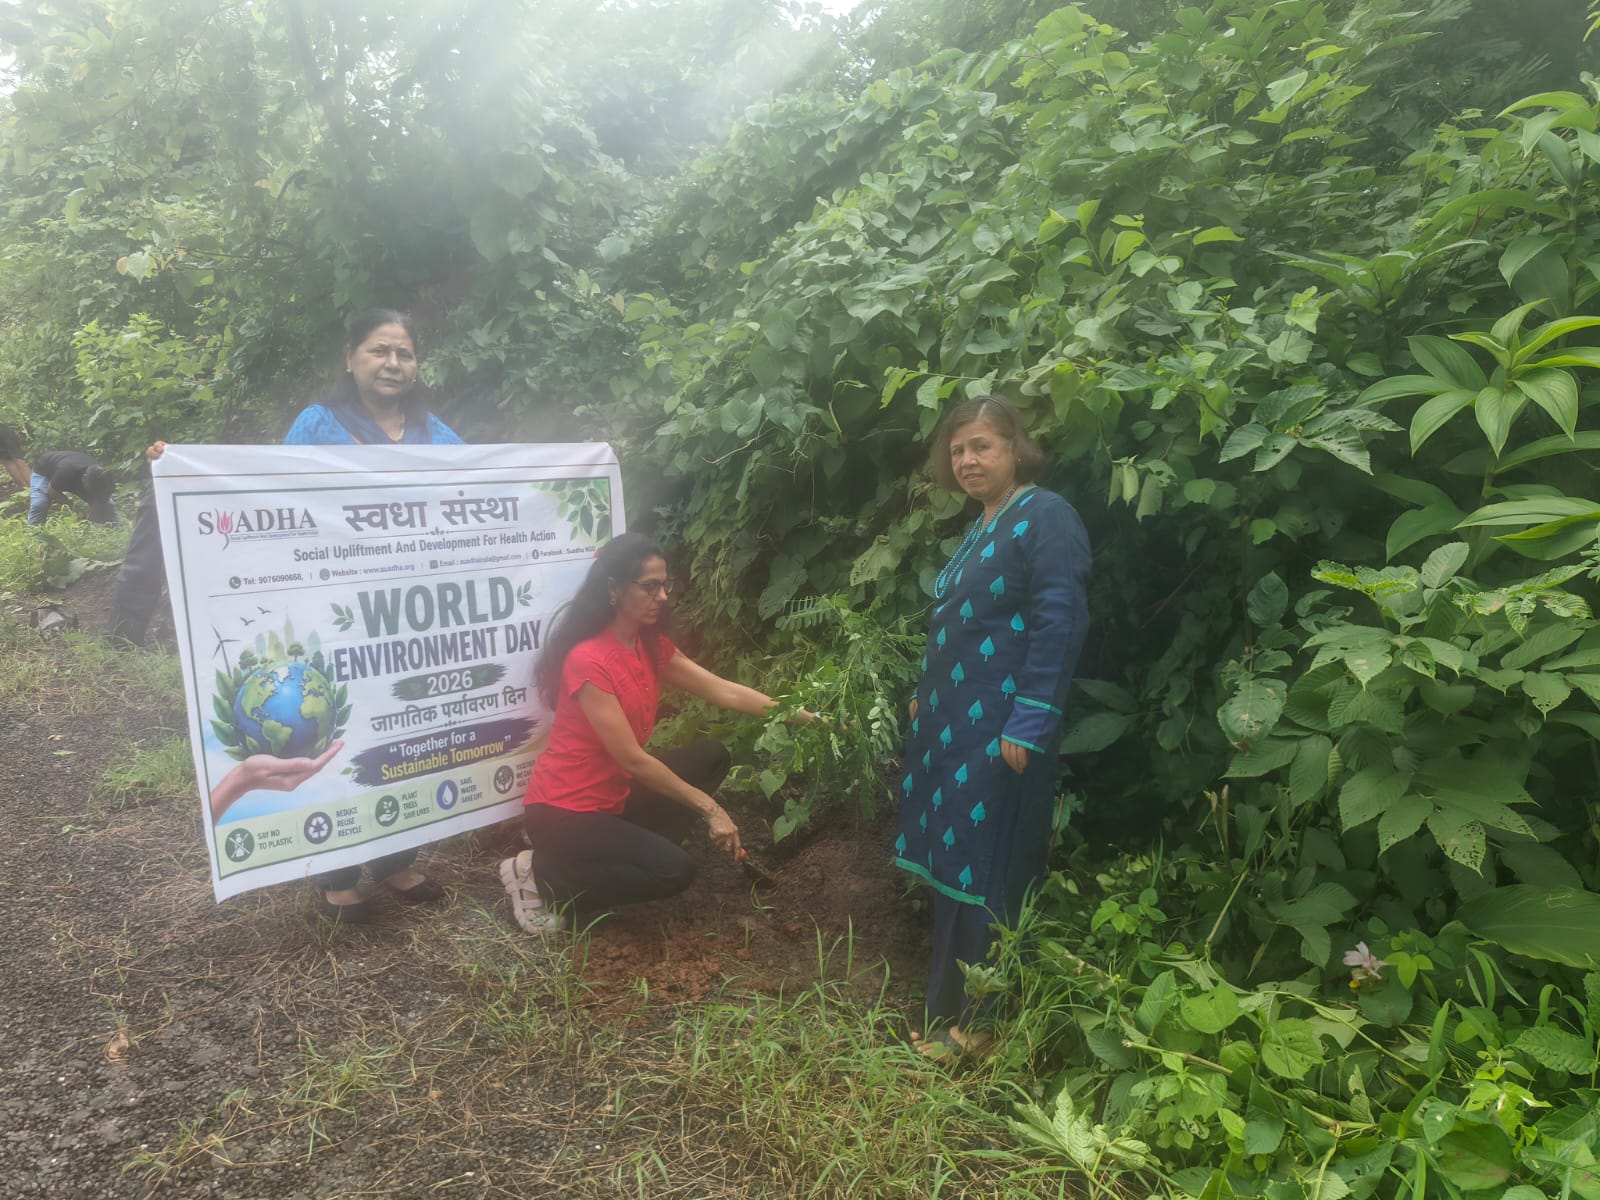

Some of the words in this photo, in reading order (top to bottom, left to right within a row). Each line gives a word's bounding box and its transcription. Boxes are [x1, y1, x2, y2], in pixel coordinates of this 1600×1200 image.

[342, 501, 428, 532] स्वधा
[439, 490, 520, 526] संस्था
[293, 546, 329, 561] Social
[333, 543, 392, 560] Upliftment
[395, 541, 417, 553] And
[419, 537, 481, 552] Development
[483, 535, 498, 546] For
[500, 532, 528, 544] Health
[530, 529, 557, 541] Action
[331, 568, 358, 577] Website
[357, 576, 515, 639] WORLD
[334, 626, 498, 682] ENVIRONMENT
[504, 619, 542, 655] DAY
[427, 671, 473, 696] 2026
[370, 704, 438, 733] जागतिक
[441, 694, 500, 719] पर्यावरण
[502, 686, 527, 707] दिन
[450, 732, 466, 748] for
[467, 731, 477, 743] a
[381, 751, 449, 781] Sustainable
[337, 816, 355, 827] REUSE
[338, 825, 362, 837] RECYCLE
[257, 830, 269, 840] SAY
[270, 829, 281, 837] NO
[258, 842, 268, 850] TO
[268, 838, 294, 848] PLASTIC
